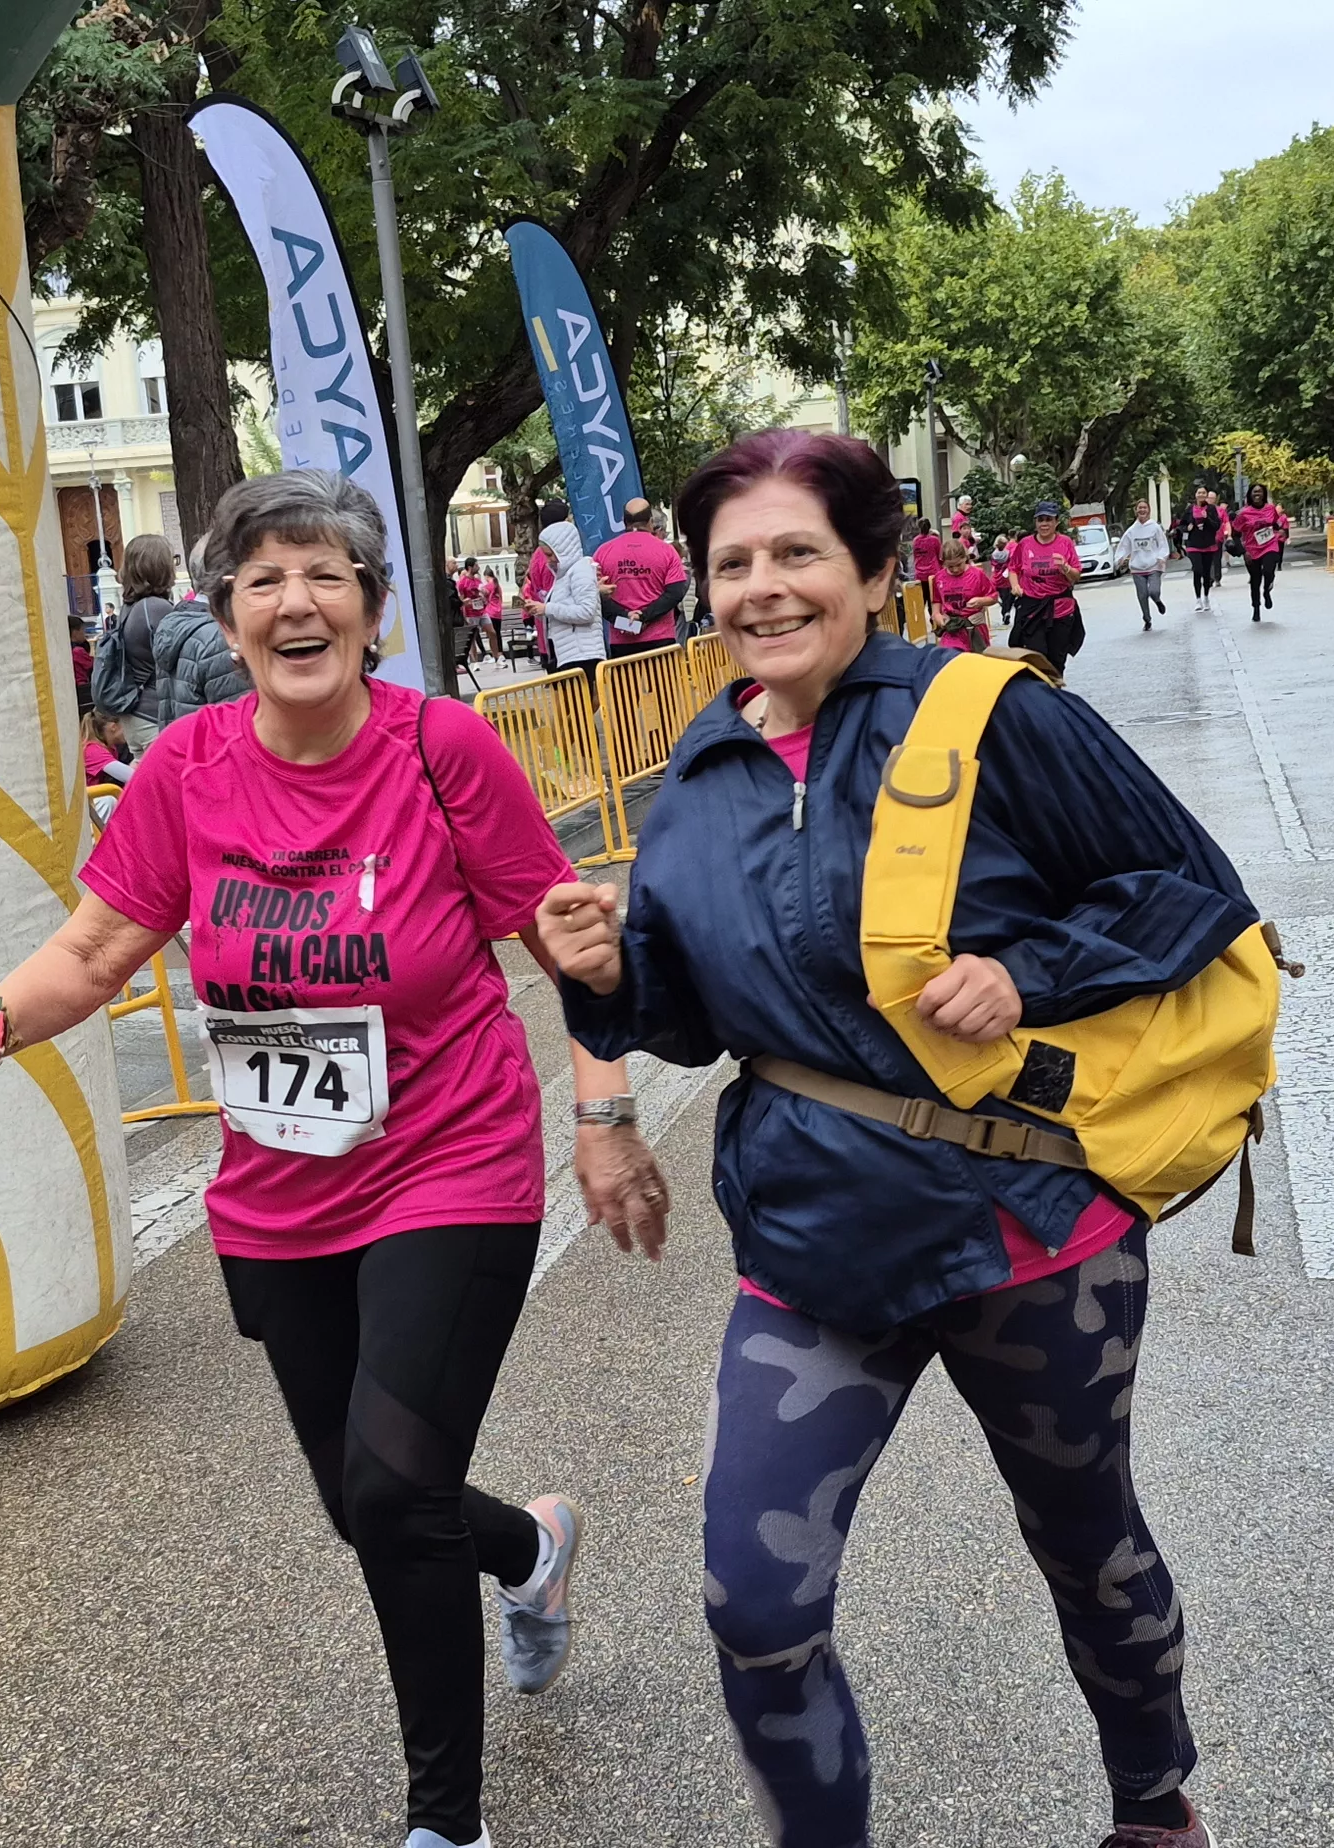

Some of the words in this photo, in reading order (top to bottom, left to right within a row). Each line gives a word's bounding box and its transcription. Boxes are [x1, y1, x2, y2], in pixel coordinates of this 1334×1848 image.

[222, 852, 268, 874] HUESCA
[271, 864, 326, 878] CONTRA
[330, 863, 344, 876] EL
[288, 848, 350, 862] CARRERA
[211, 878, 335, 932] UNIDOS
[252, 933, 294, 983] EN
[300, 933, 391, 984] CADA
[218, 1034, 279, 1046] CONTRA
[280, 1036, 299, 1046] EL
[246, 1051, 349, 1112] 174
